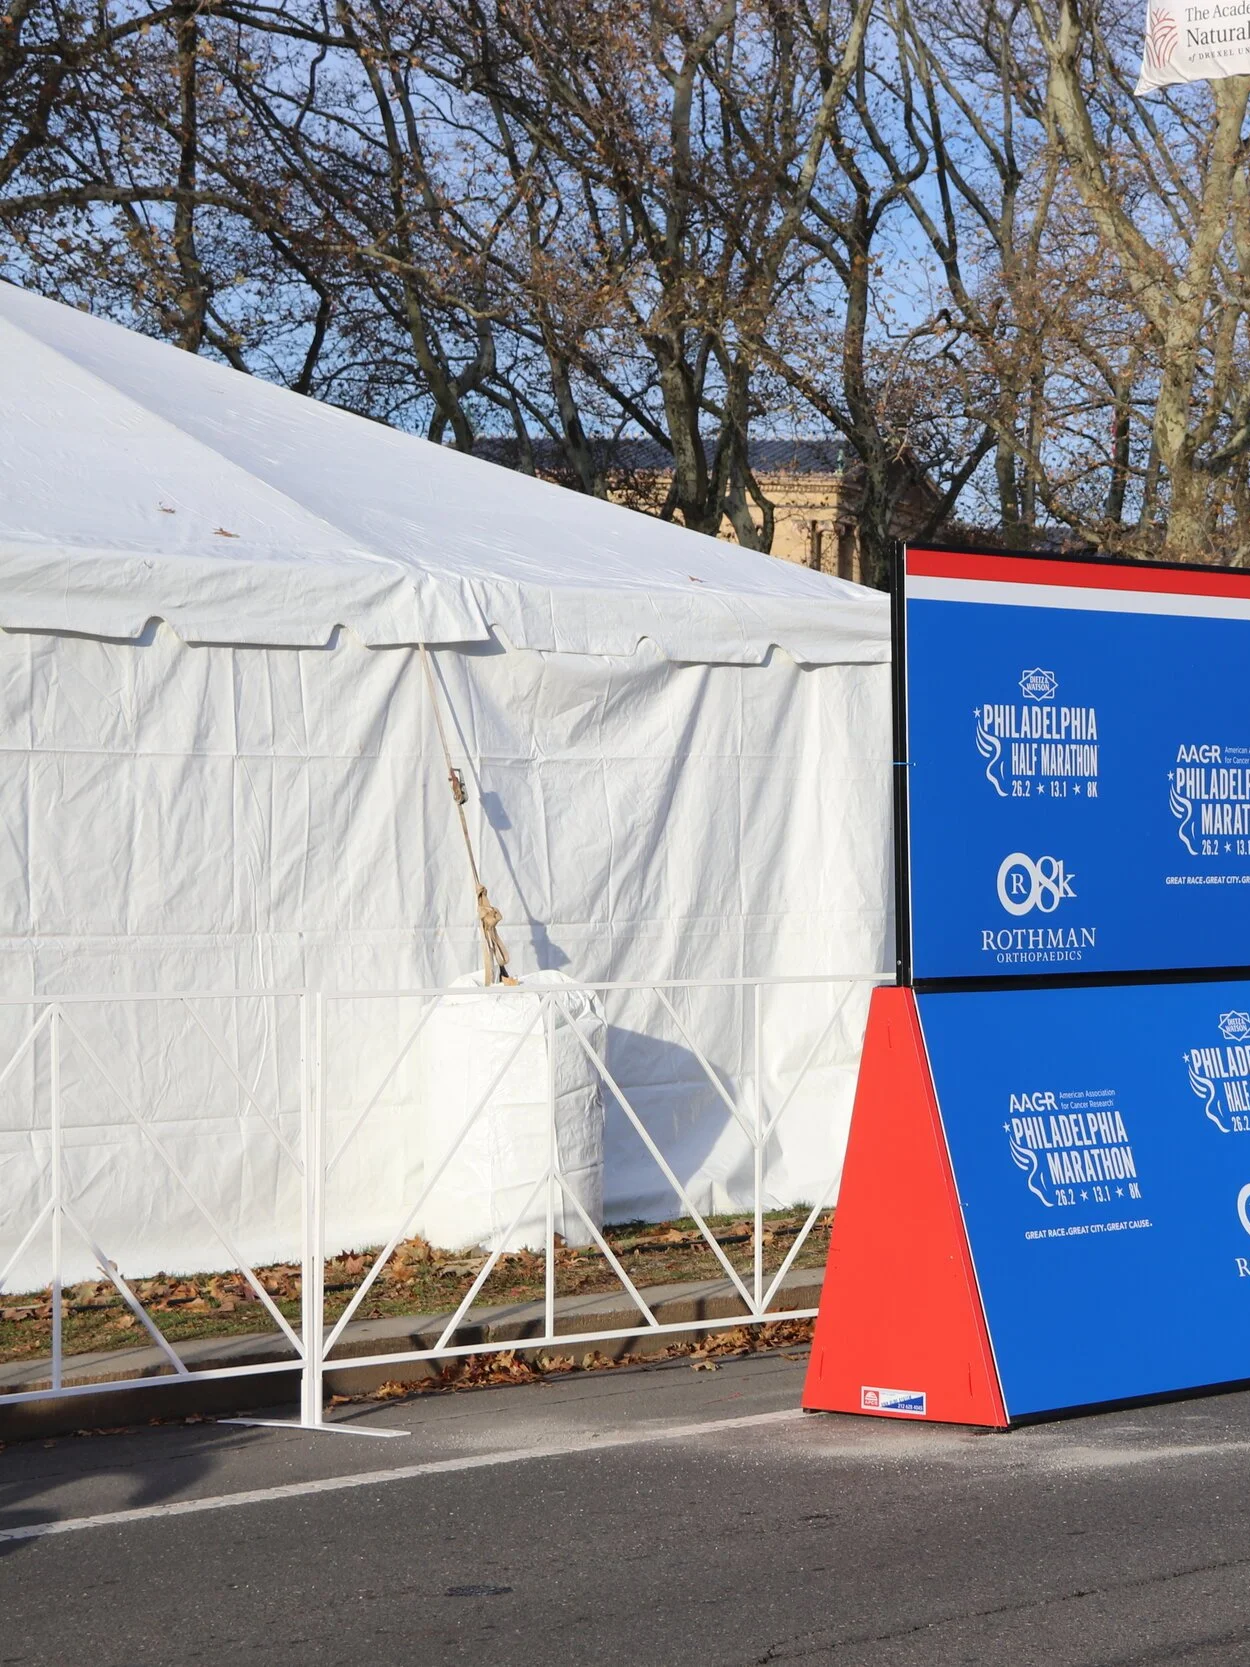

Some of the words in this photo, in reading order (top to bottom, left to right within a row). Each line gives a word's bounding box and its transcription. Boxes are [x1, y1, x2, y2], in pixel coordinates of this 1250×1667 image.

[1185, 7, 1209, 22] The
[1186, 21, 1250, 48] Natural
[1199, 49, 1234, 60] DREXEL
[984, 704, 1098, 740] PHILADELPHIA
[1012, 743, 1037, 776] HALF
[1041, 744, 1098, 777] MARATHON
[1176, 744, 1222, 763] AACR
[1012, 780, 1030, 797] 26.2
[1050, 781, 1066, 797] 13.1
[1087, 782, 1098, 797] 8K
[1202, 840, 1218, 855] 26.2
[1237, 840, 1250, 855] 13.1
[981, 928, 1097, 950] ROTHMAN
[997, 951, 1082, 963] ORTHOPAEDICS
[1009, 1092, 1058, 1113] AACR
[1224, 1080, 1250, 1112] HALF
[1012, 1111, 1128, 1149] PHILADELPHIA
[1232, 1116, 1250, 1132] 26.2
[1046, 1146, 1137, 1185] MARATHON
[1056, 1189, 1076, 1206] 26.2
[1093, 1185, 1111, 1202] 13.1
[1129, 1183, 1141, 1199] 8K
